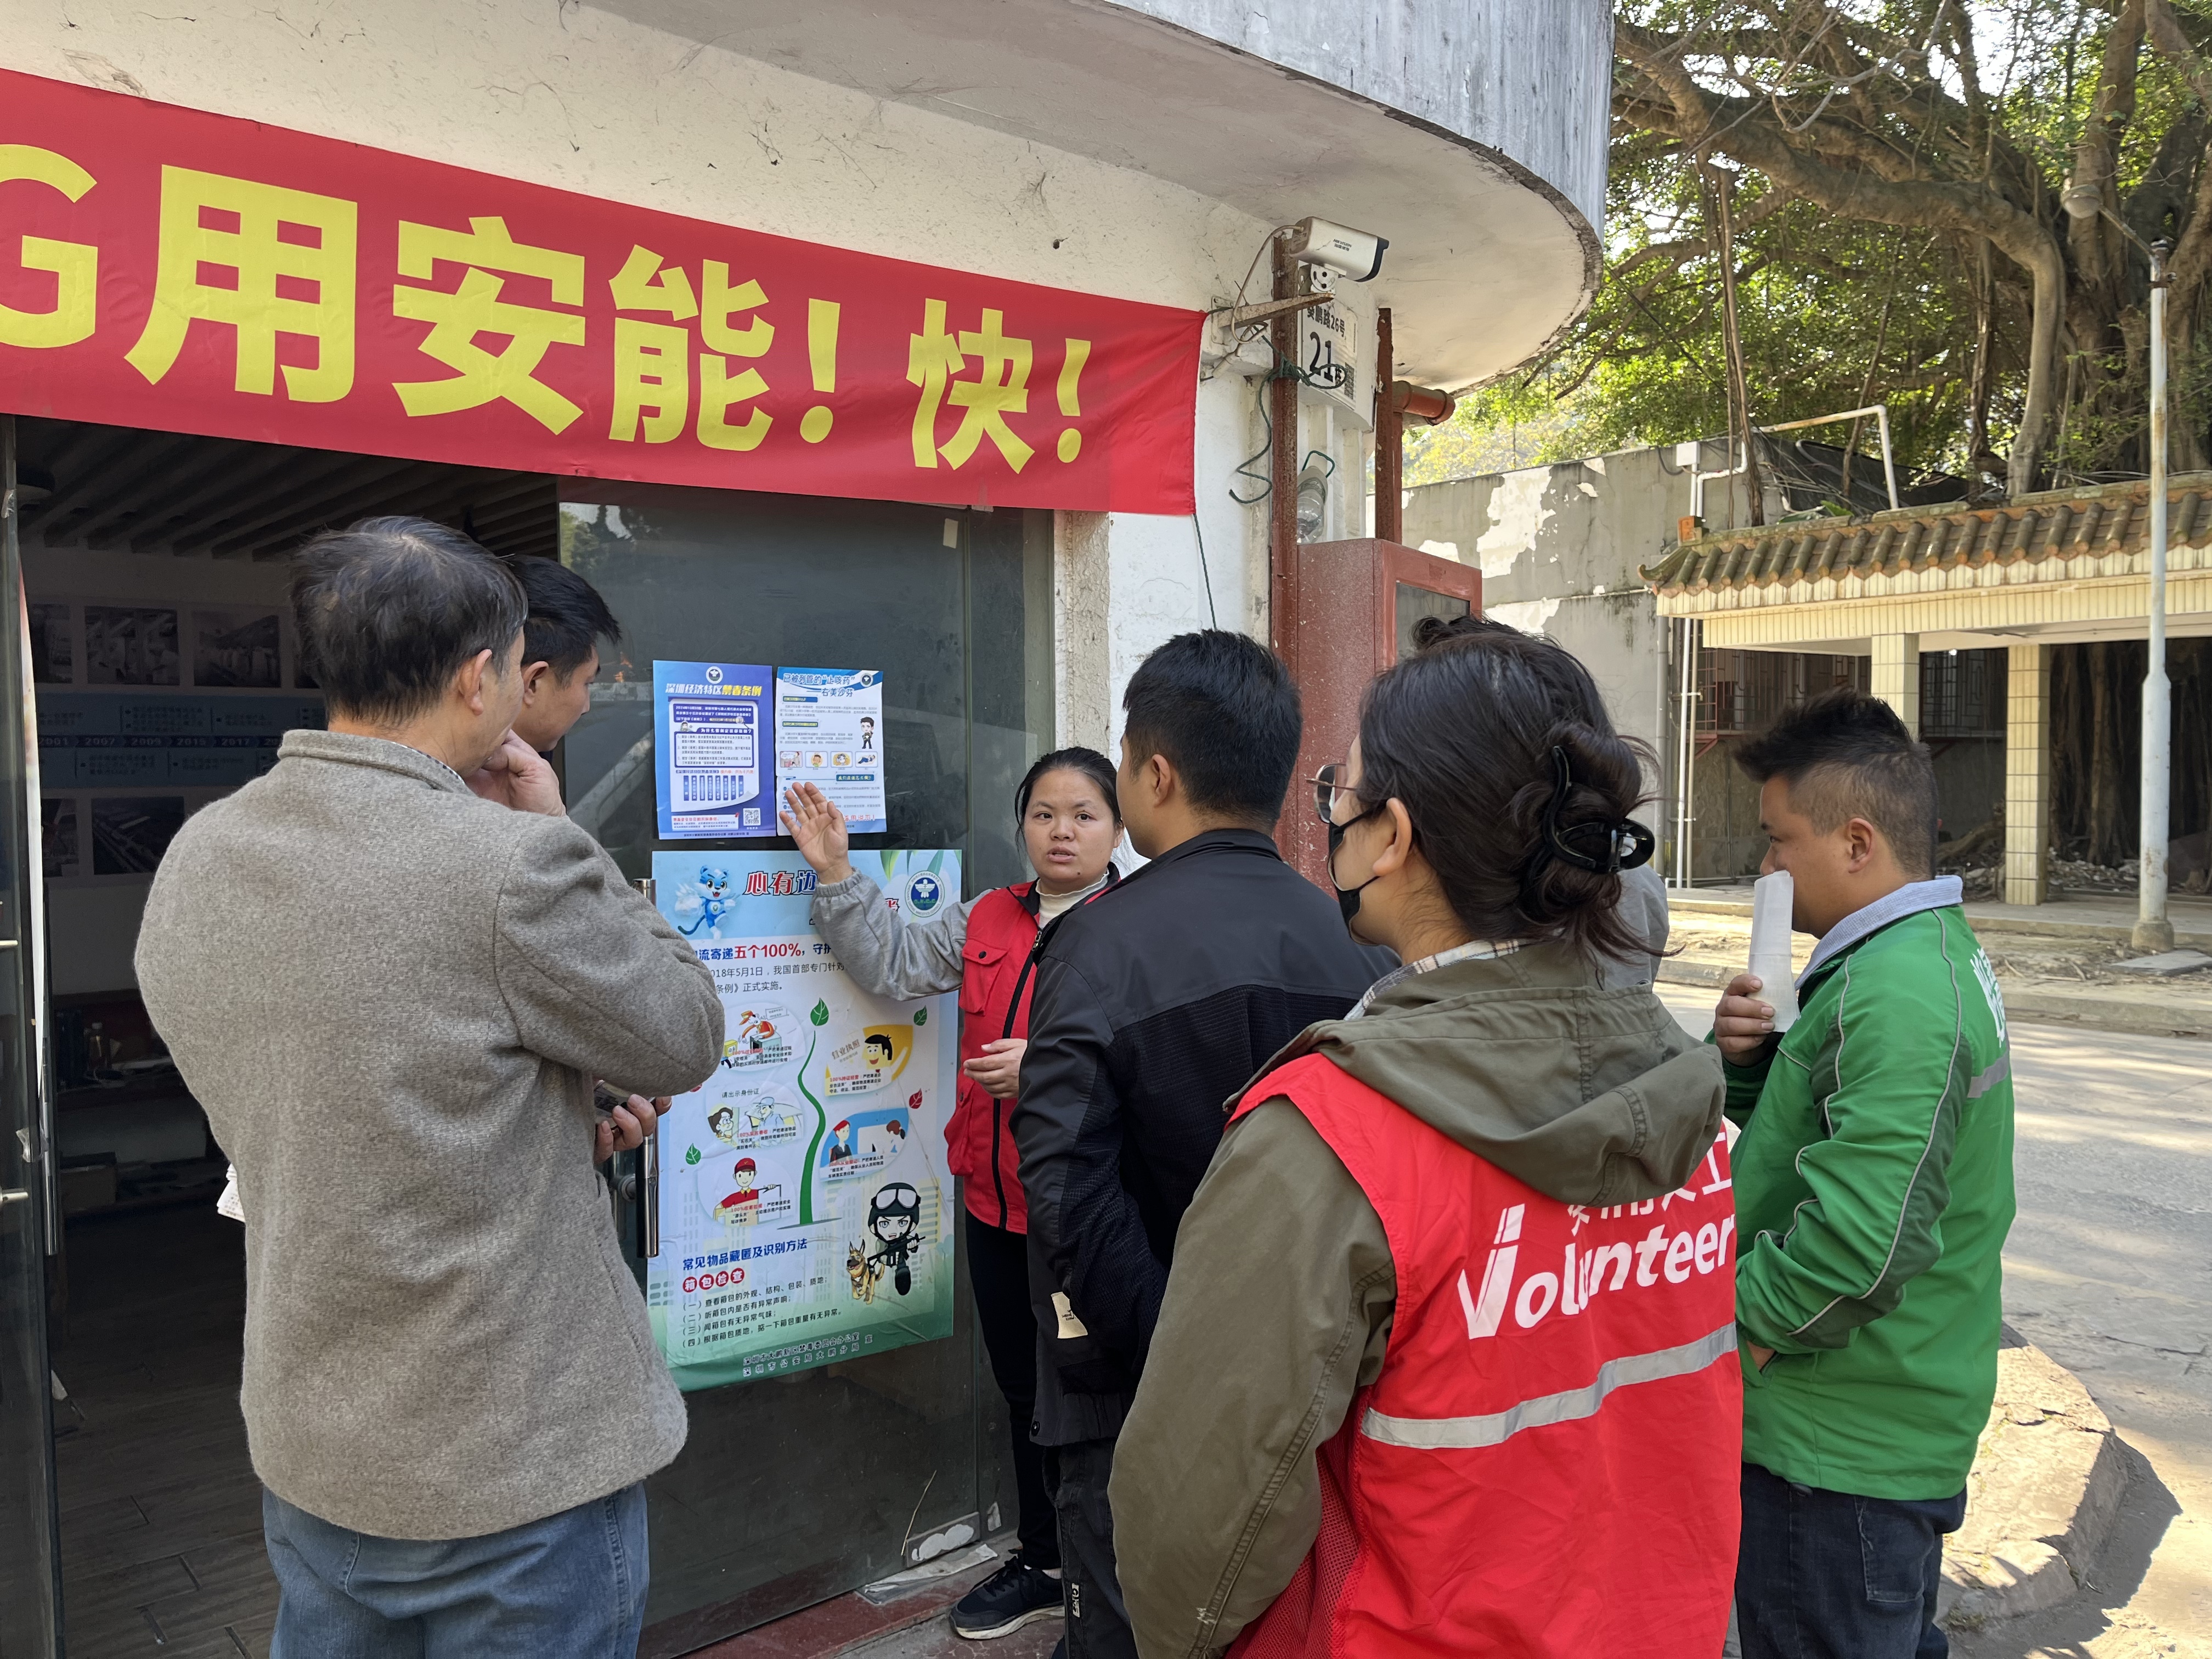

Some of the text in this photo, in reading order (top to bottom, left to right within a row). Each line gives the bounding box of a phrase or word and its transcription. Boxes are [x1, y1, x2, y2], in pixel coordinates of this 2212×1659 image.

[783, 673, 855, 685] 已被列管的“止咳药”
[665, 683, 762, 697] 深圳经济特区禁毒条例
[721, 1088, 760, 1098] 请出示身份证
[682, 1238, 808, 1271] 常见物品藏匿及识别方法
[684, 1269, 743, 1292] 箱包检查
[1457, 1203, 1736, 1340] Volunteer
